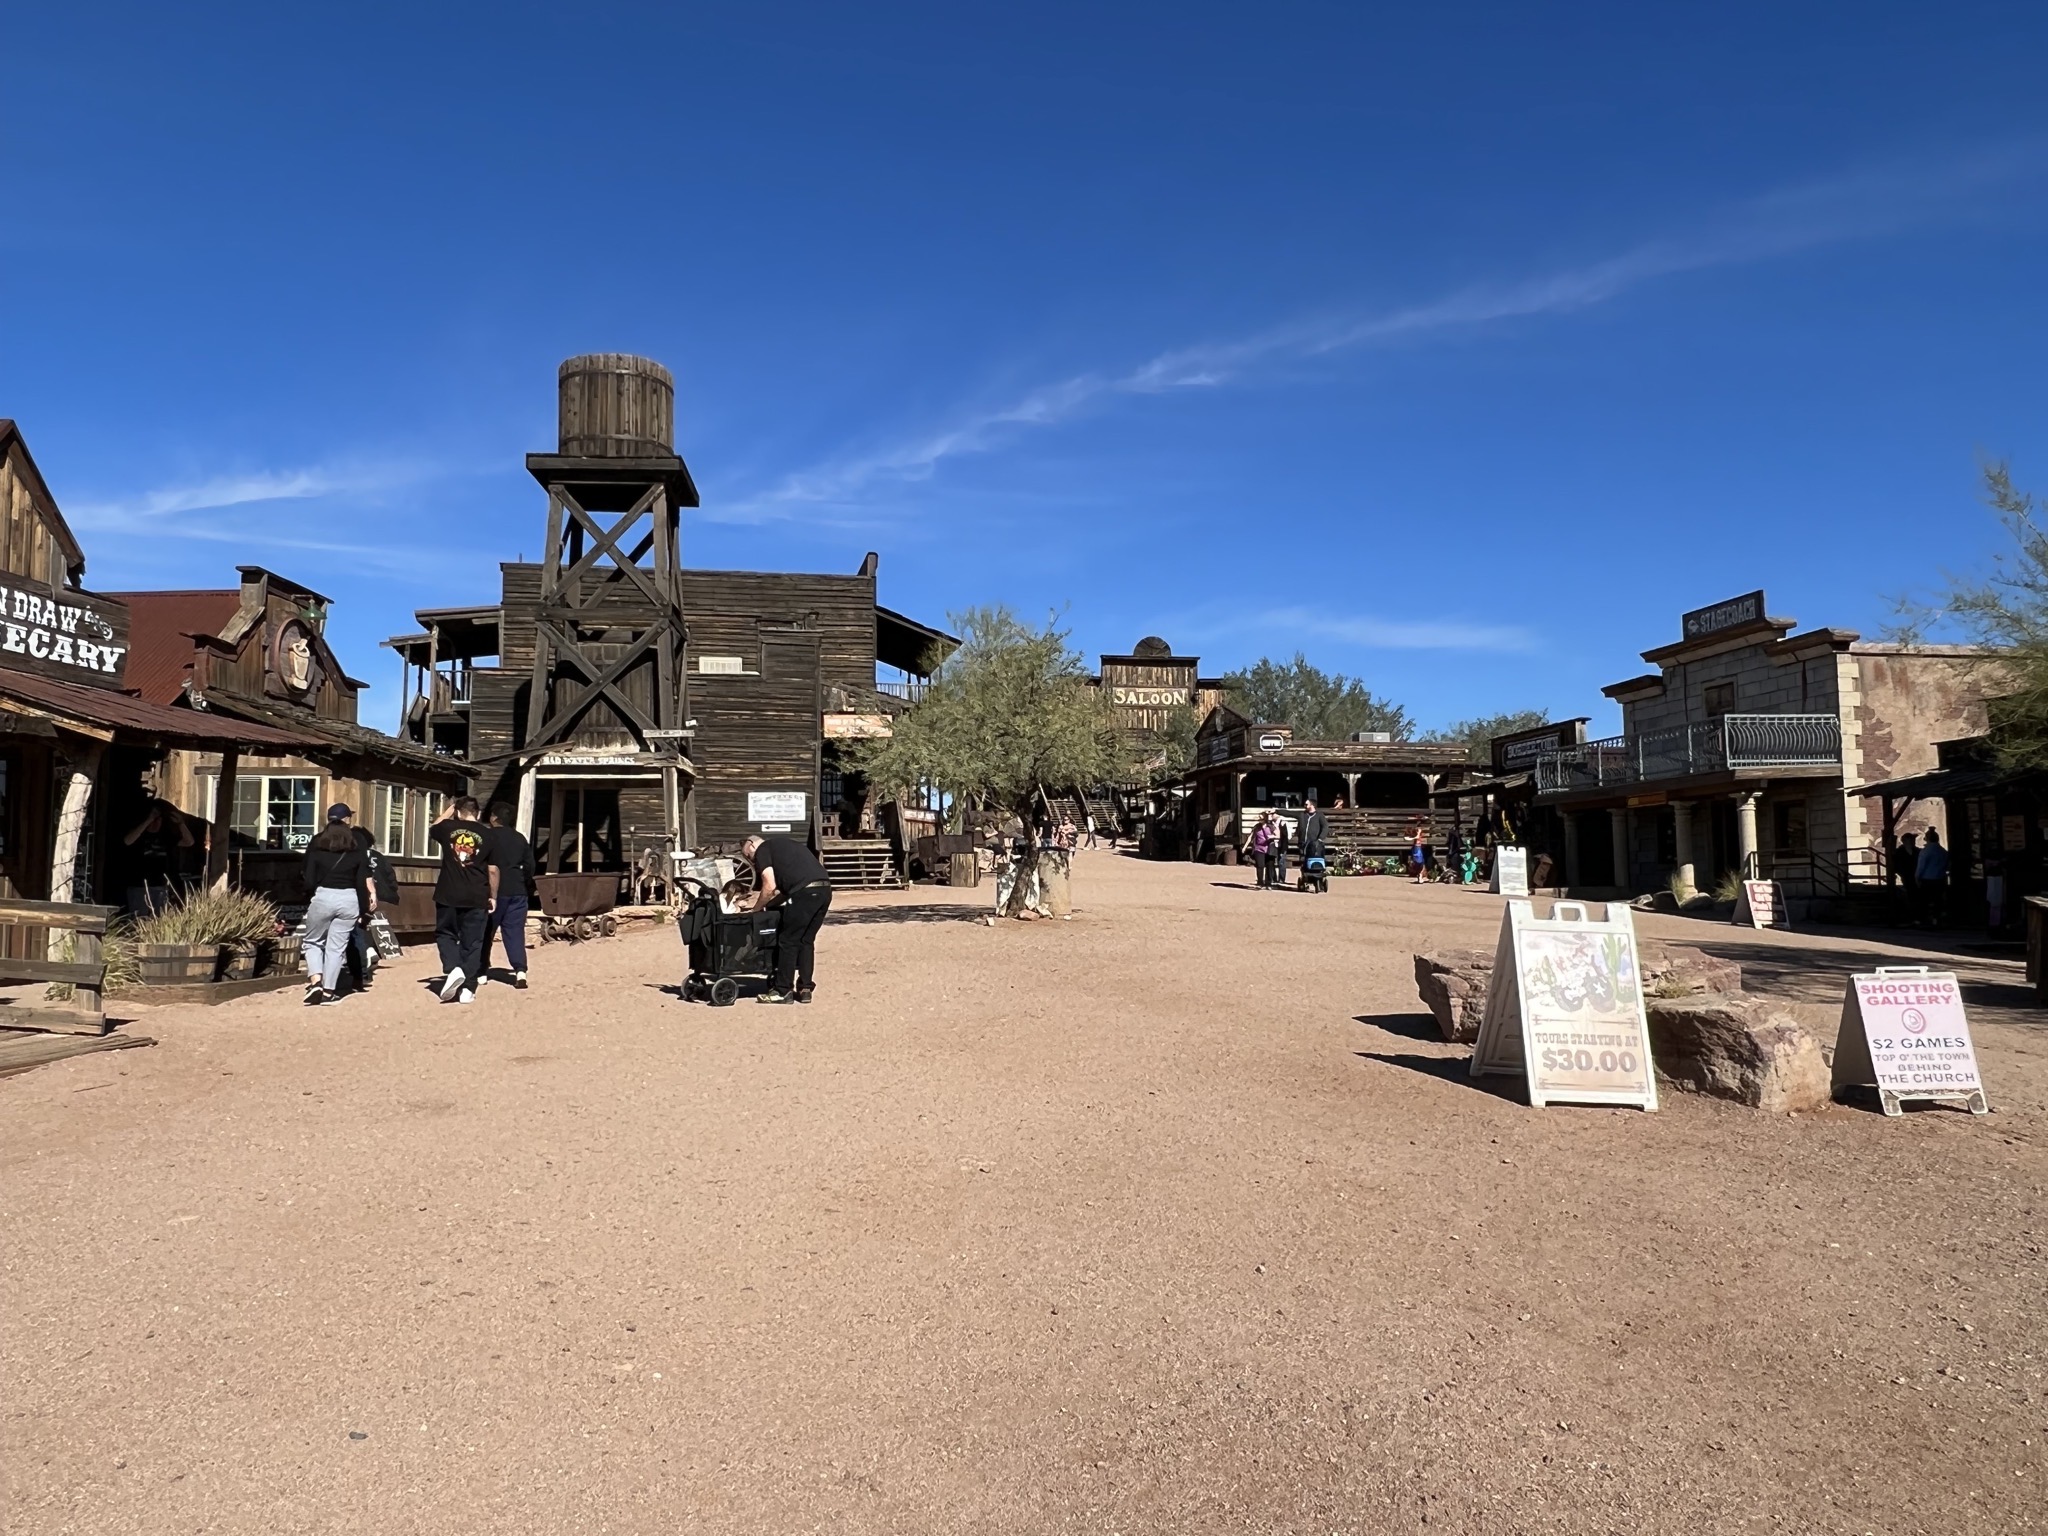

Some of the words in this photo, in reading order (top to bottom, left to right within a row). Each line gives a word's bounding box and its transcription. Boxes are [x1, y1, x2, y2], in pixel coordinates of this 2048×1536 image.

[13, 590, 82, 634] DRAW
[0, 621, 126, 673] ECARY
[1114, 689, 1186, 705] SALOON
[598, 757, 635, 765] SPRINGS
[1860, 983, 1955, 994] SHOOTING
[1866, 995, 1952, 1006] GALLERY
[1535, 1033, 1568, 1045] TOURS
[1571, 1033, 1622, 1047] STARTING
[1625, 1035, 1638, 1047] AT
[1901, 1037, 1965, 1049] GAMES
[1541, 1047, 1637, 1073] $30.00
[1875, 1054, 1895, 1062] TOP
[1914, 1053, 1935, 1061] THE
[1937, 1053, 1970, 1061] TOWN
[1898, 1063, 1952, 1072] BEHIND
[1880, 1074, 1909, 1084] THE
[1913, 1073, 1976, 1083] CHURCH
